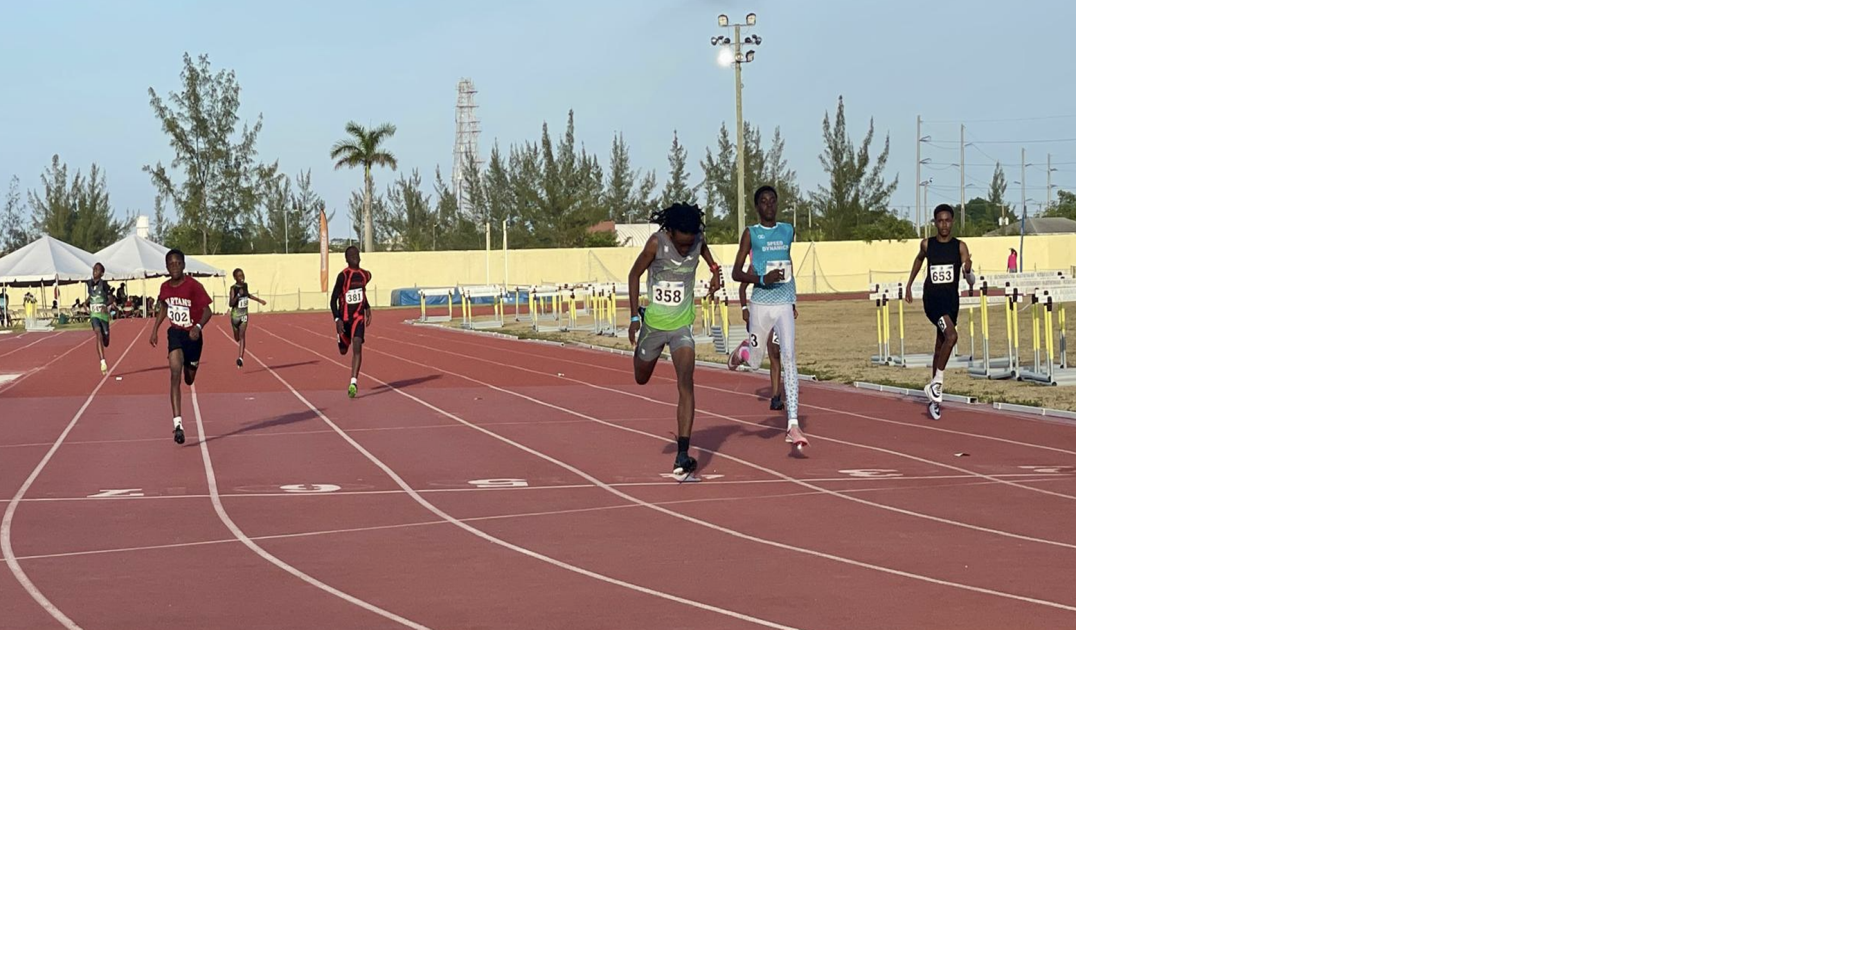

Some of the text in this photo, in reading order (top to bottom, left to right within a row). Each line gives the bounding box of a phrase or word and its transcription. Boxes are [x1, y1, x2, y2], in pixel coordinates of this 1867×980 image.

[932, 270, 952, 282] 653
[347, 293, 361, 302] 381
[655, 288, 682, 303] 358
[169, 310, 189, 322] 302
[750, 333, 758, 348] 3
